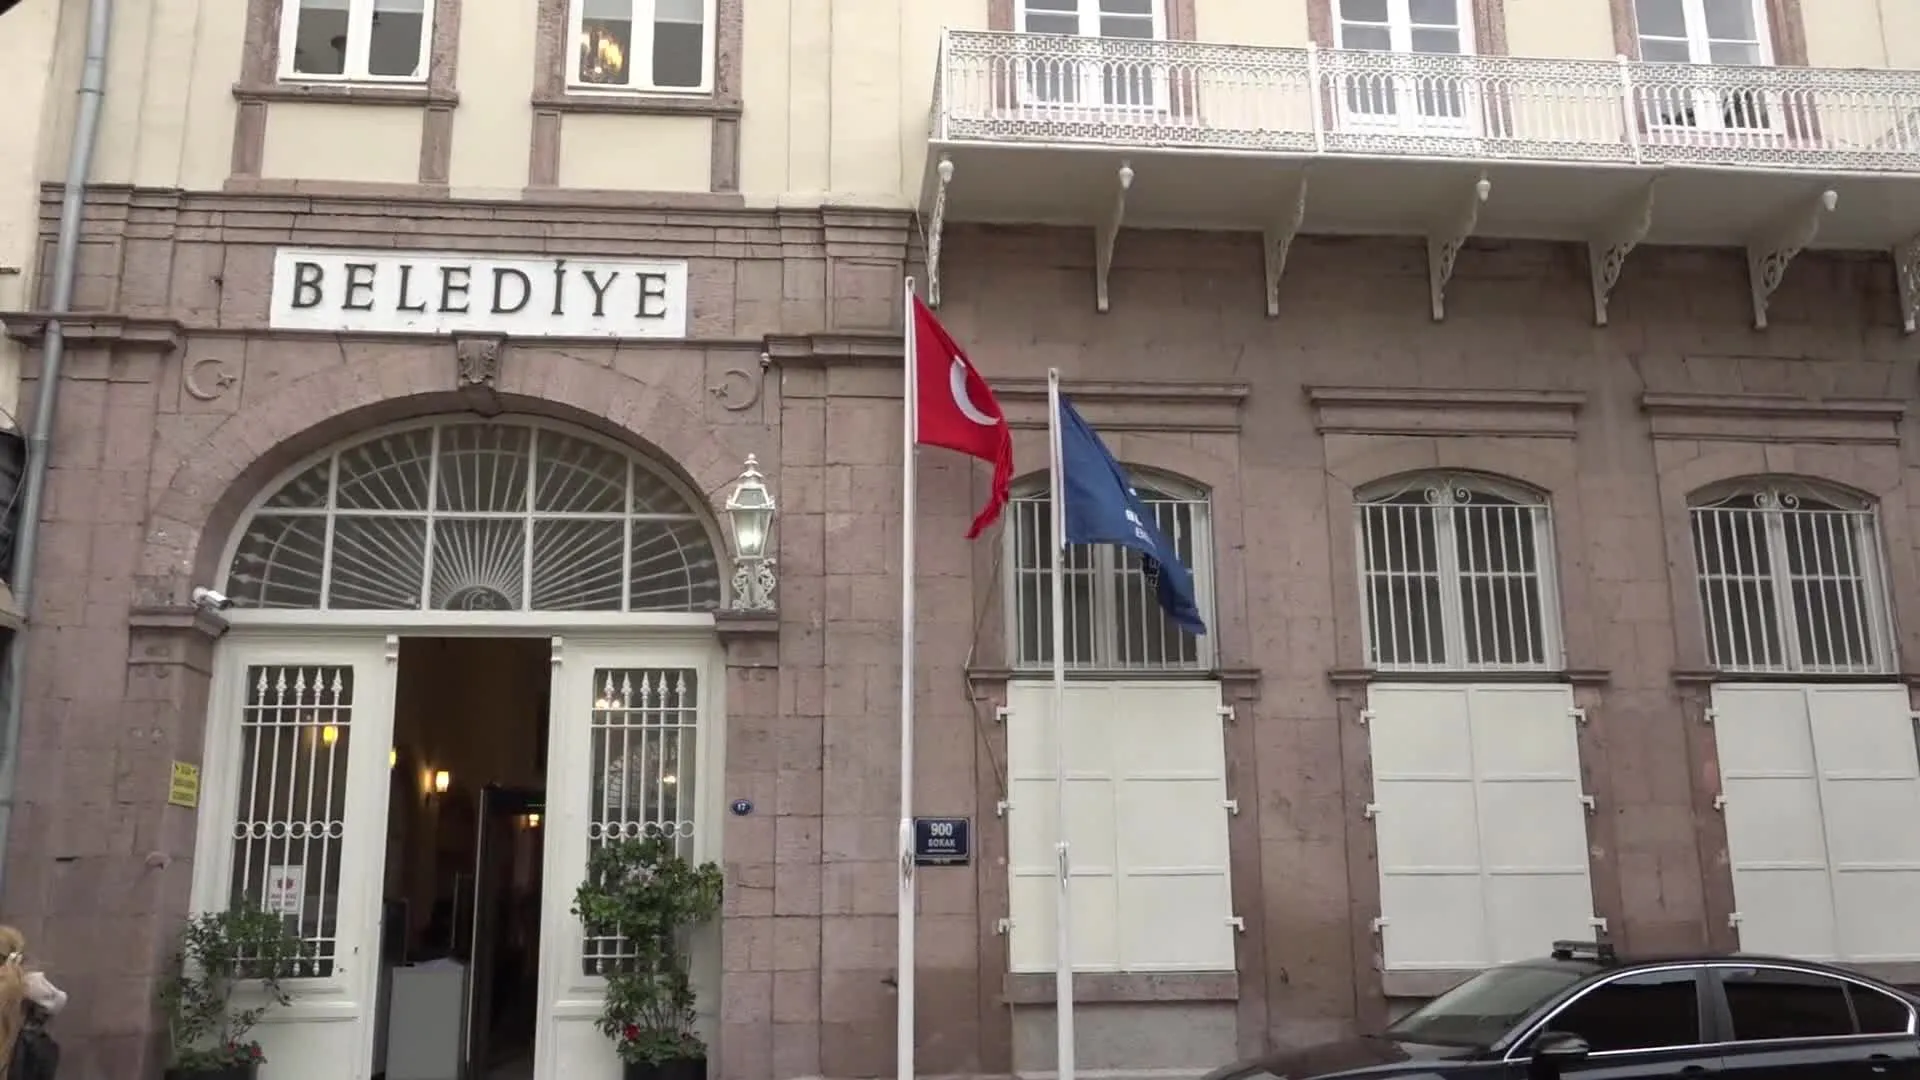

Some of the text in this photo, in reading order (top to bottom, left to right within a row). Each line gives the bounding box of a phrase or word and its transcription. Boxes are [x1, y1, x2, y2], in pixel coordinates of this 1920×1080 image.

[291, 260, 667, 318] BELEDİYE
[930, 823, 953, 836] 900
[928, 839, 956, 847] SOKAK
